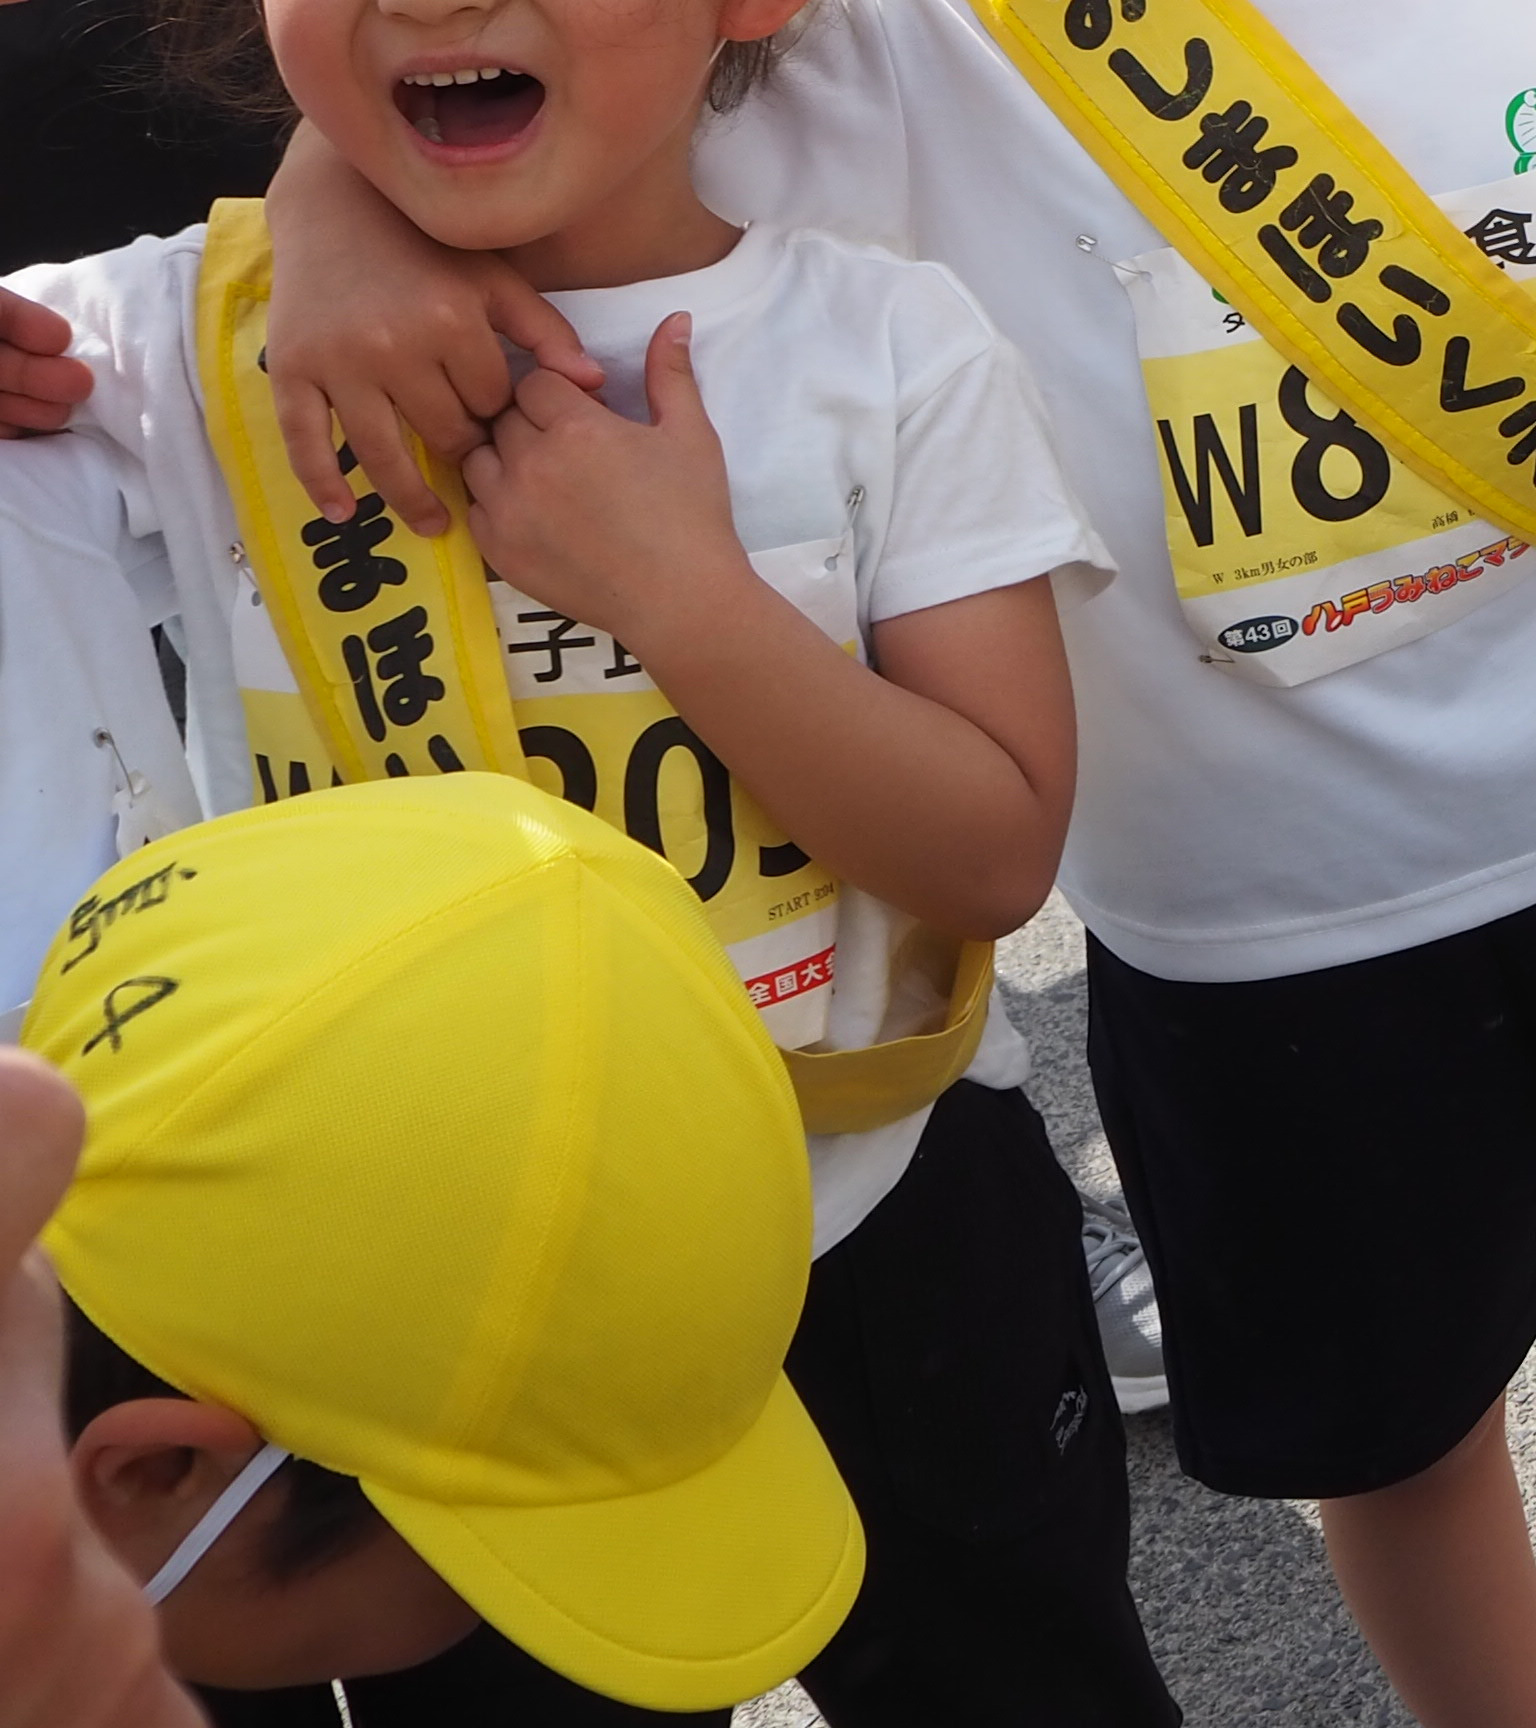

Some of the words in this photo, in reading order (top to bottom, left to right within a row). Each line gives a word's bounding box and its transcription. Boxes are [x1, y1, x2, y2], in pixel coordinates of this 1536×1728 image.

[1211, 572, 1225, 585] W
[1233, 550, 1319, 581] 3km男女の部
[1223, 620, 1294, 649] 第43回
[767, 891, 811, 921] START
